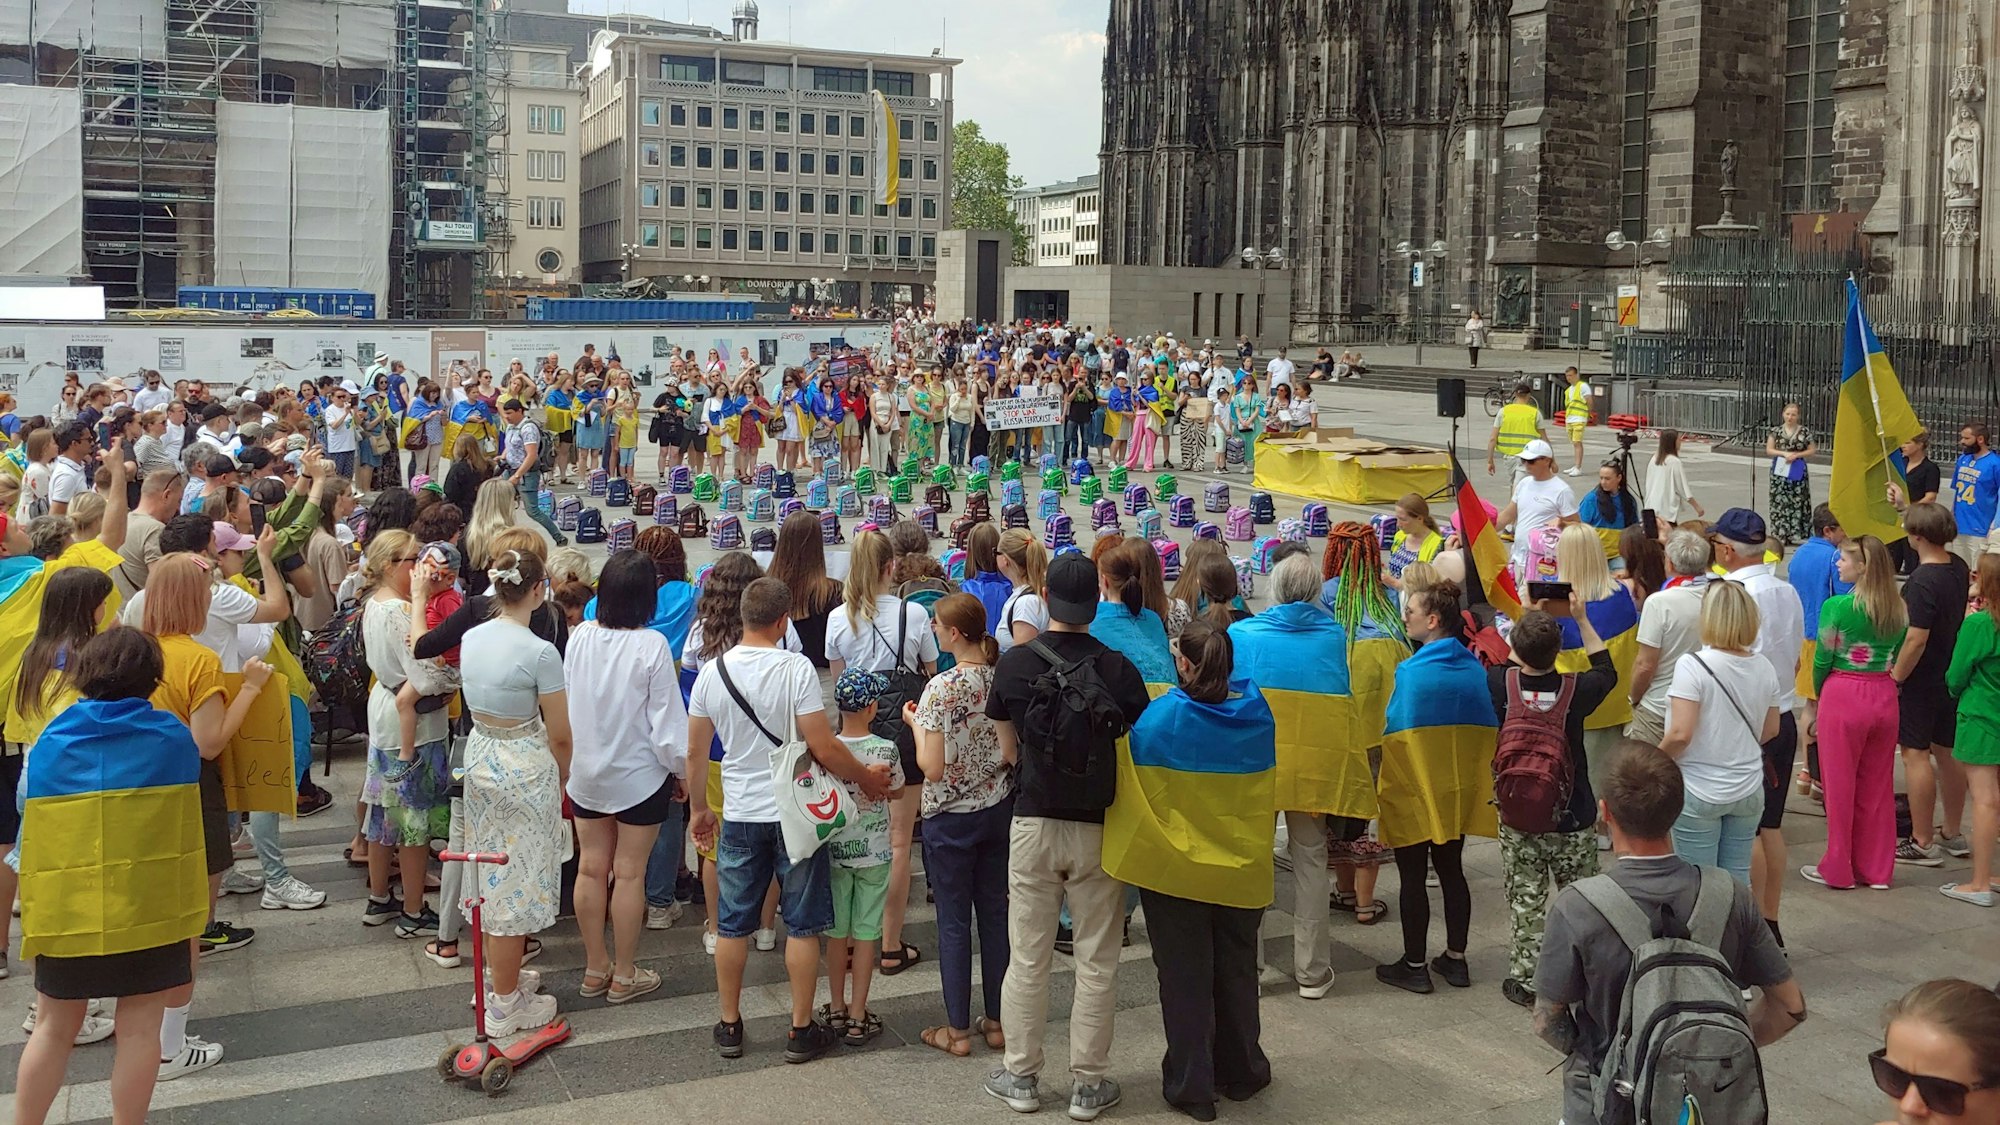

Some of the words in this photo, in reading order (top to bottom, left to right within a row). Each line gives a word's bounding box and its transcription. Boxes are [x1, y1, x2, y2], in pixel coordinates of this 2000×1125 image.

[747, 280, 795, 289] DOMFORUM
[1003, 410, 1019, 418] STOP
[1022, 408, 1037, 416] WAR
[1003, 418, 1023, 426] RUSSIA
[1024, 414, 1051, 424] TERRORIST
[1955, 481, 1976, 506] 24
